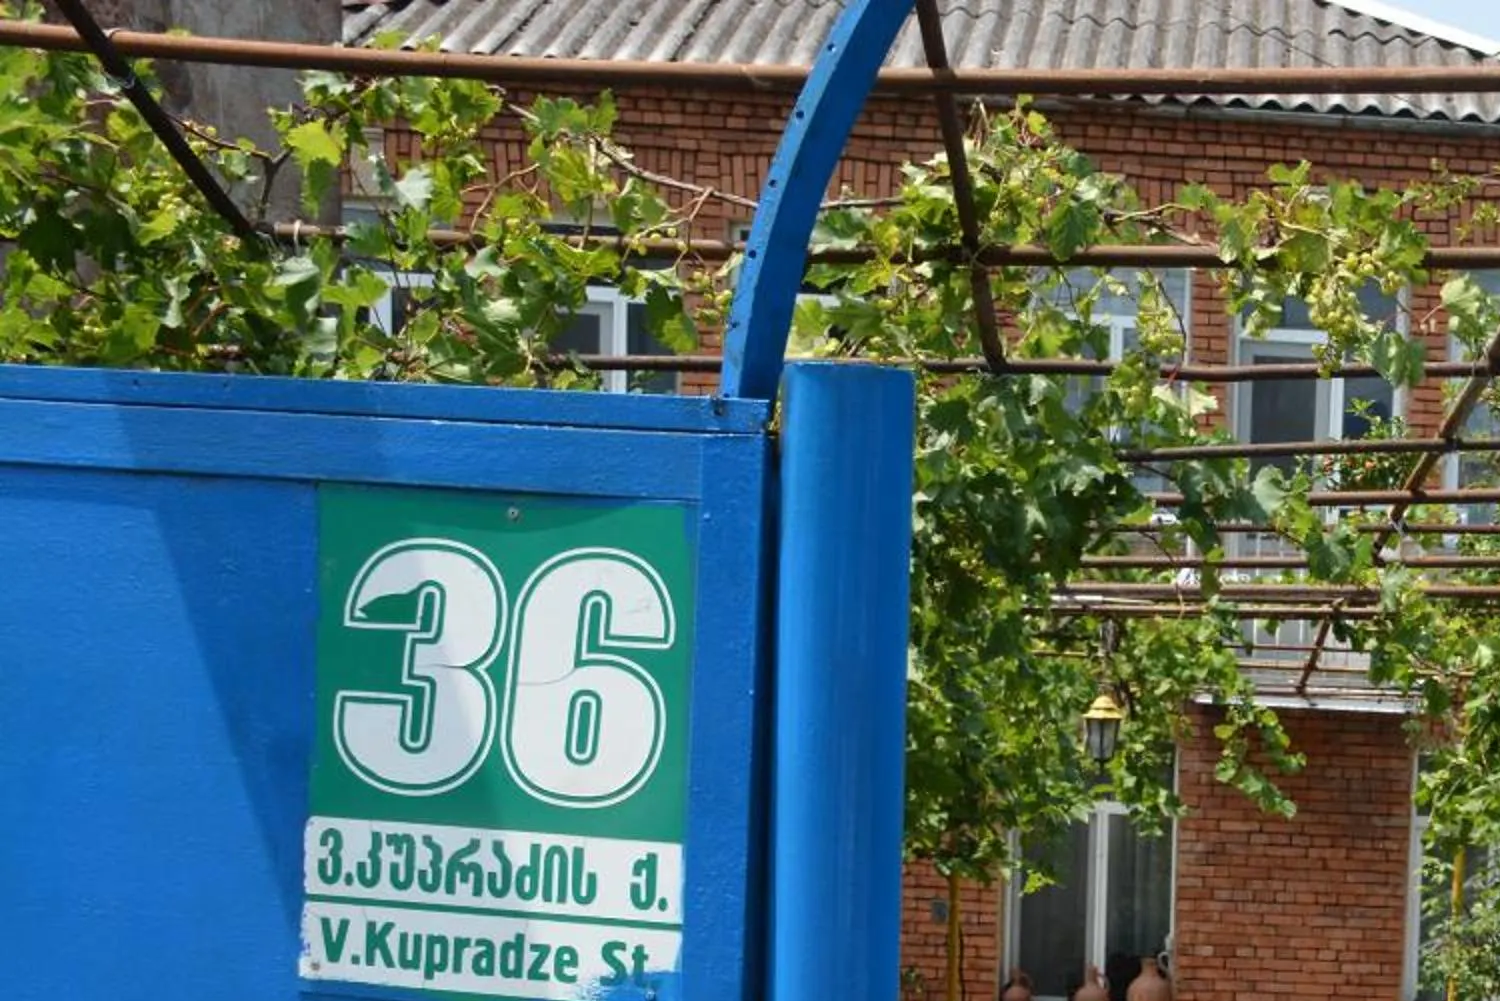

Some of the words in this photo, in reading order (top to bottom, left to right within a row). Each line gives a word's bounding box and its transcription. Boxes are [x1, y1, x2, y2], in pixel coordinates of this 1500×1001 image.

[333, 537, 675, 808] 36
[317, 827, 597, 905] ვ.კუპრაძის
[629, 852, 670, 911] ქ.
[320, 917, 579, 983] V.Kupradze
